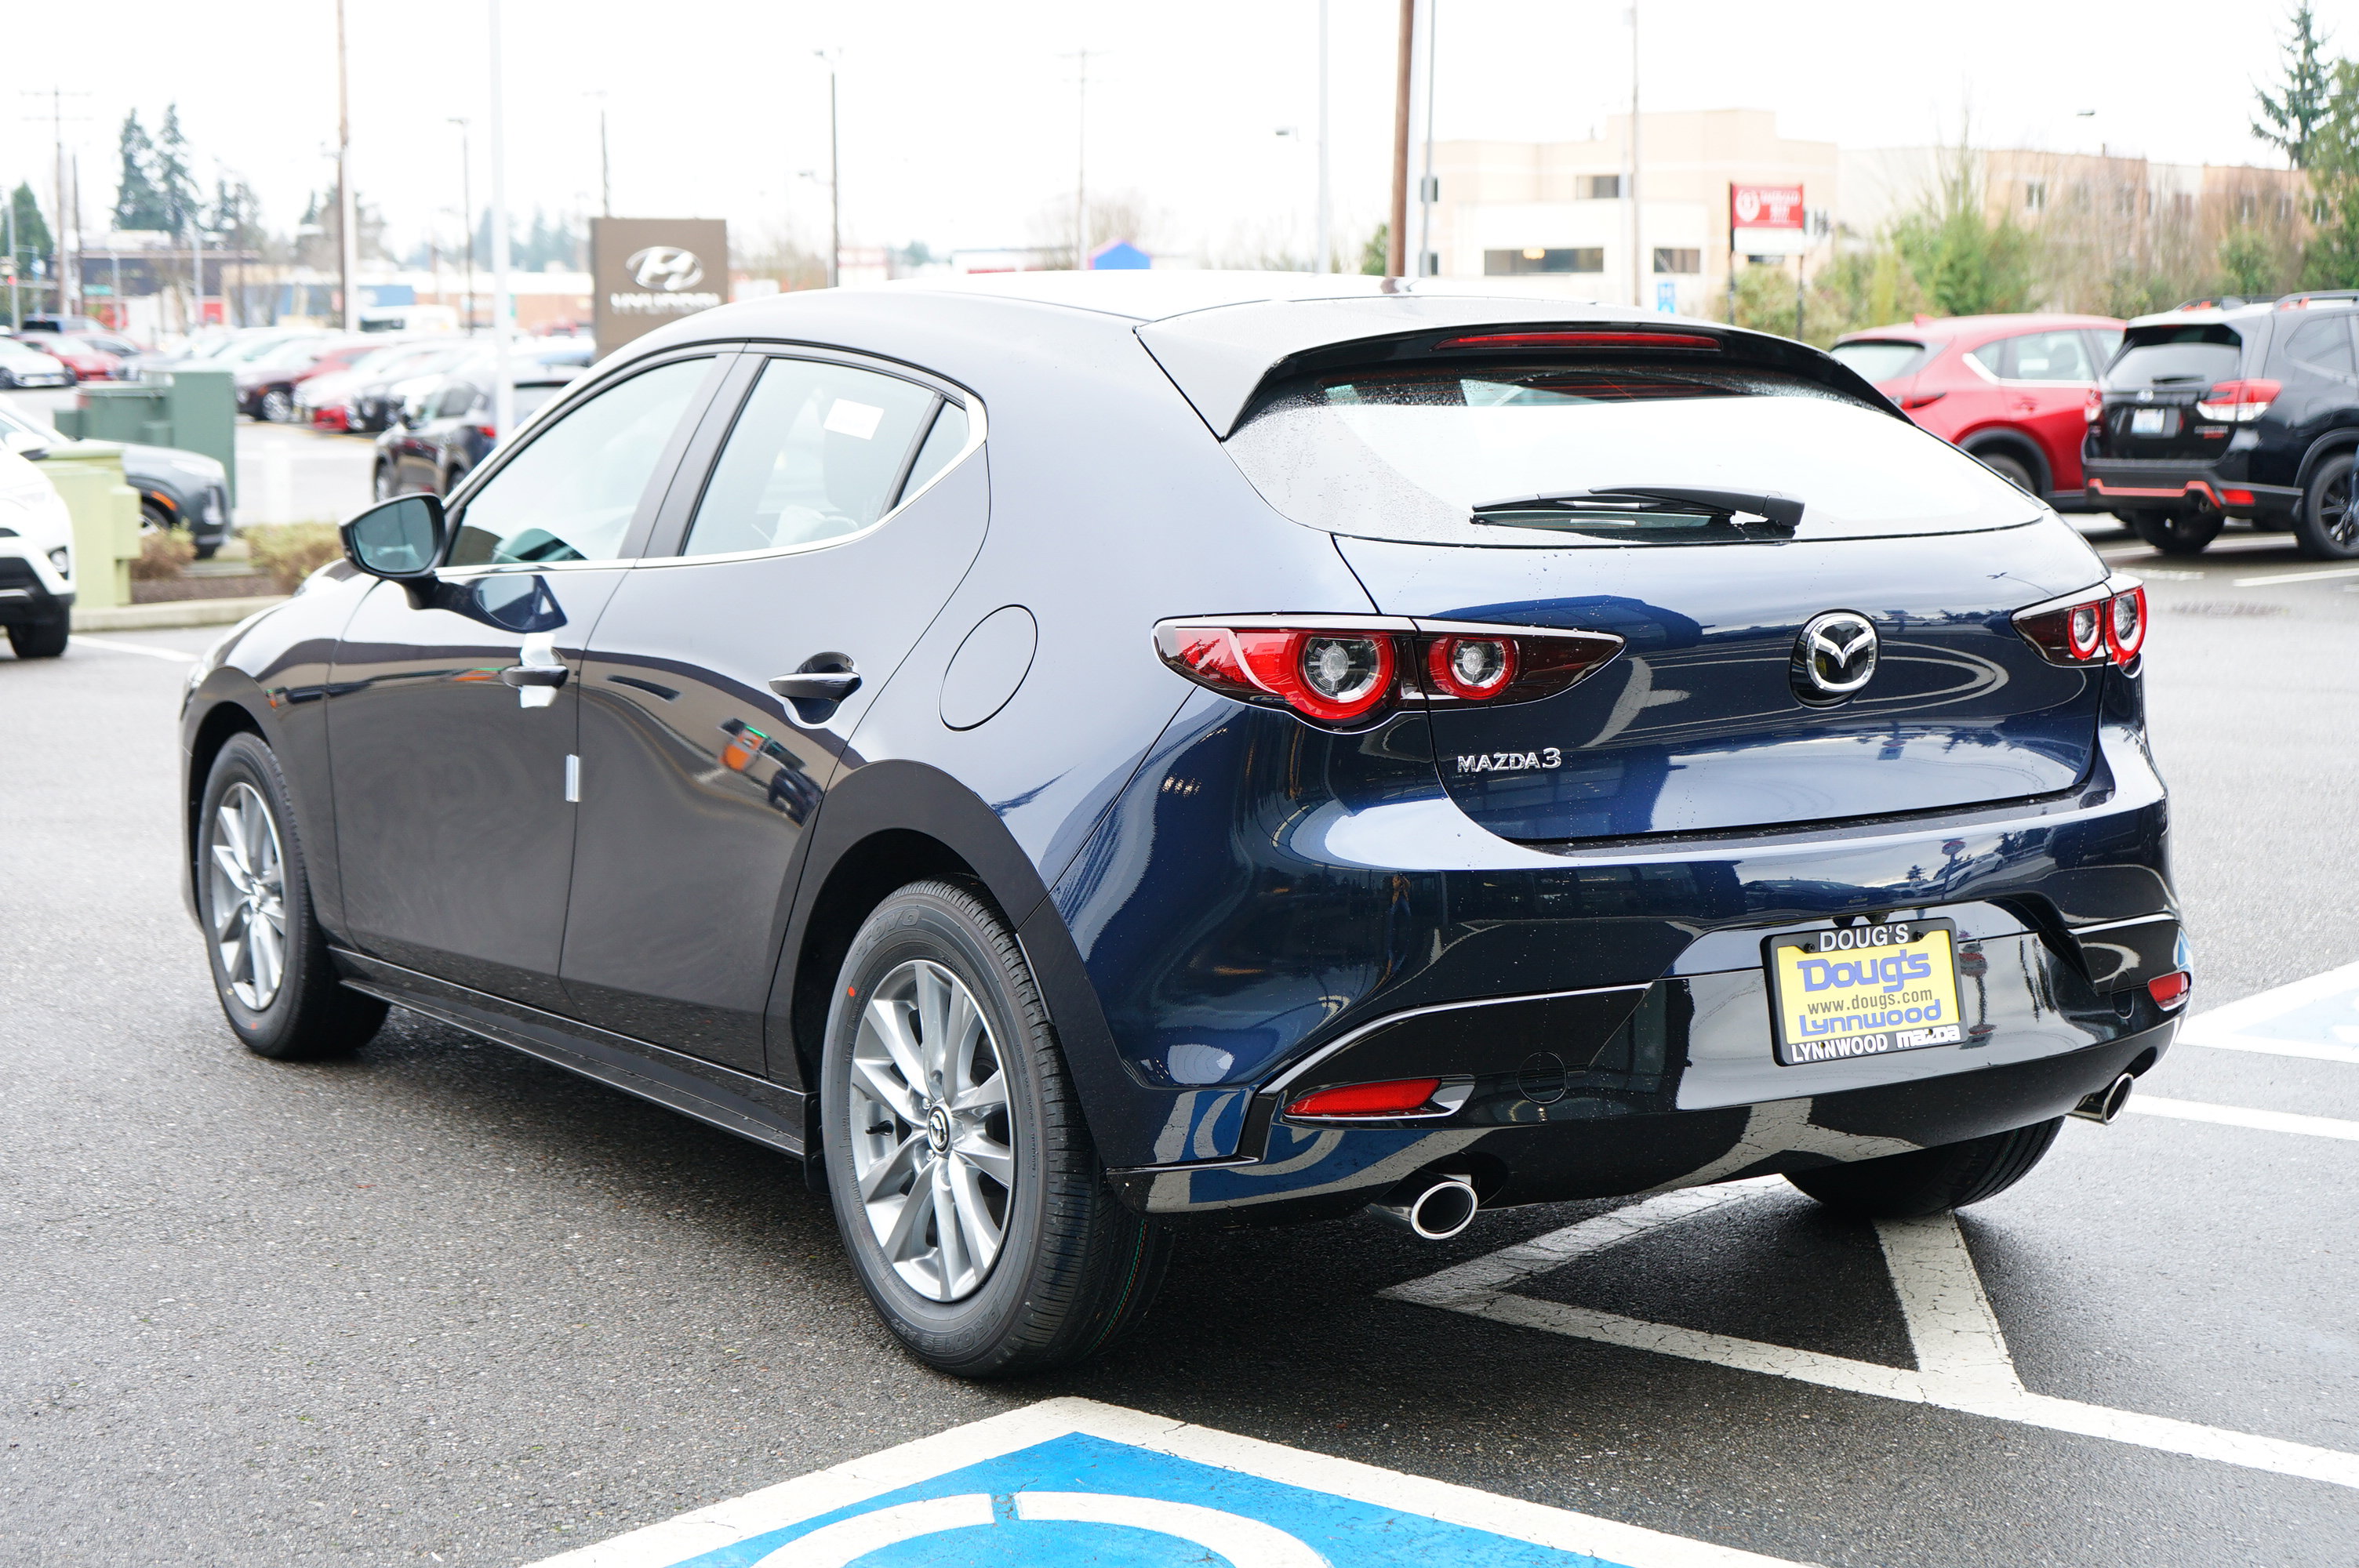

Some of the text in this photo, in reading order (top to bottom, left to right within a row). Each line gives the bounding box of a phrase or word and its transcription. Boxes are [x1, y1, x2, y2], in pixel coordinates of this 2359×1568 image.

[1819, 924, 1909, 952] DOUG'S
[1808, 989, 1933, 1014] www.dougs.com
[1799, 999, 1942, 1036] Lynnwood
[1791, 1034, 1888, 1062] LYNNWOOD
